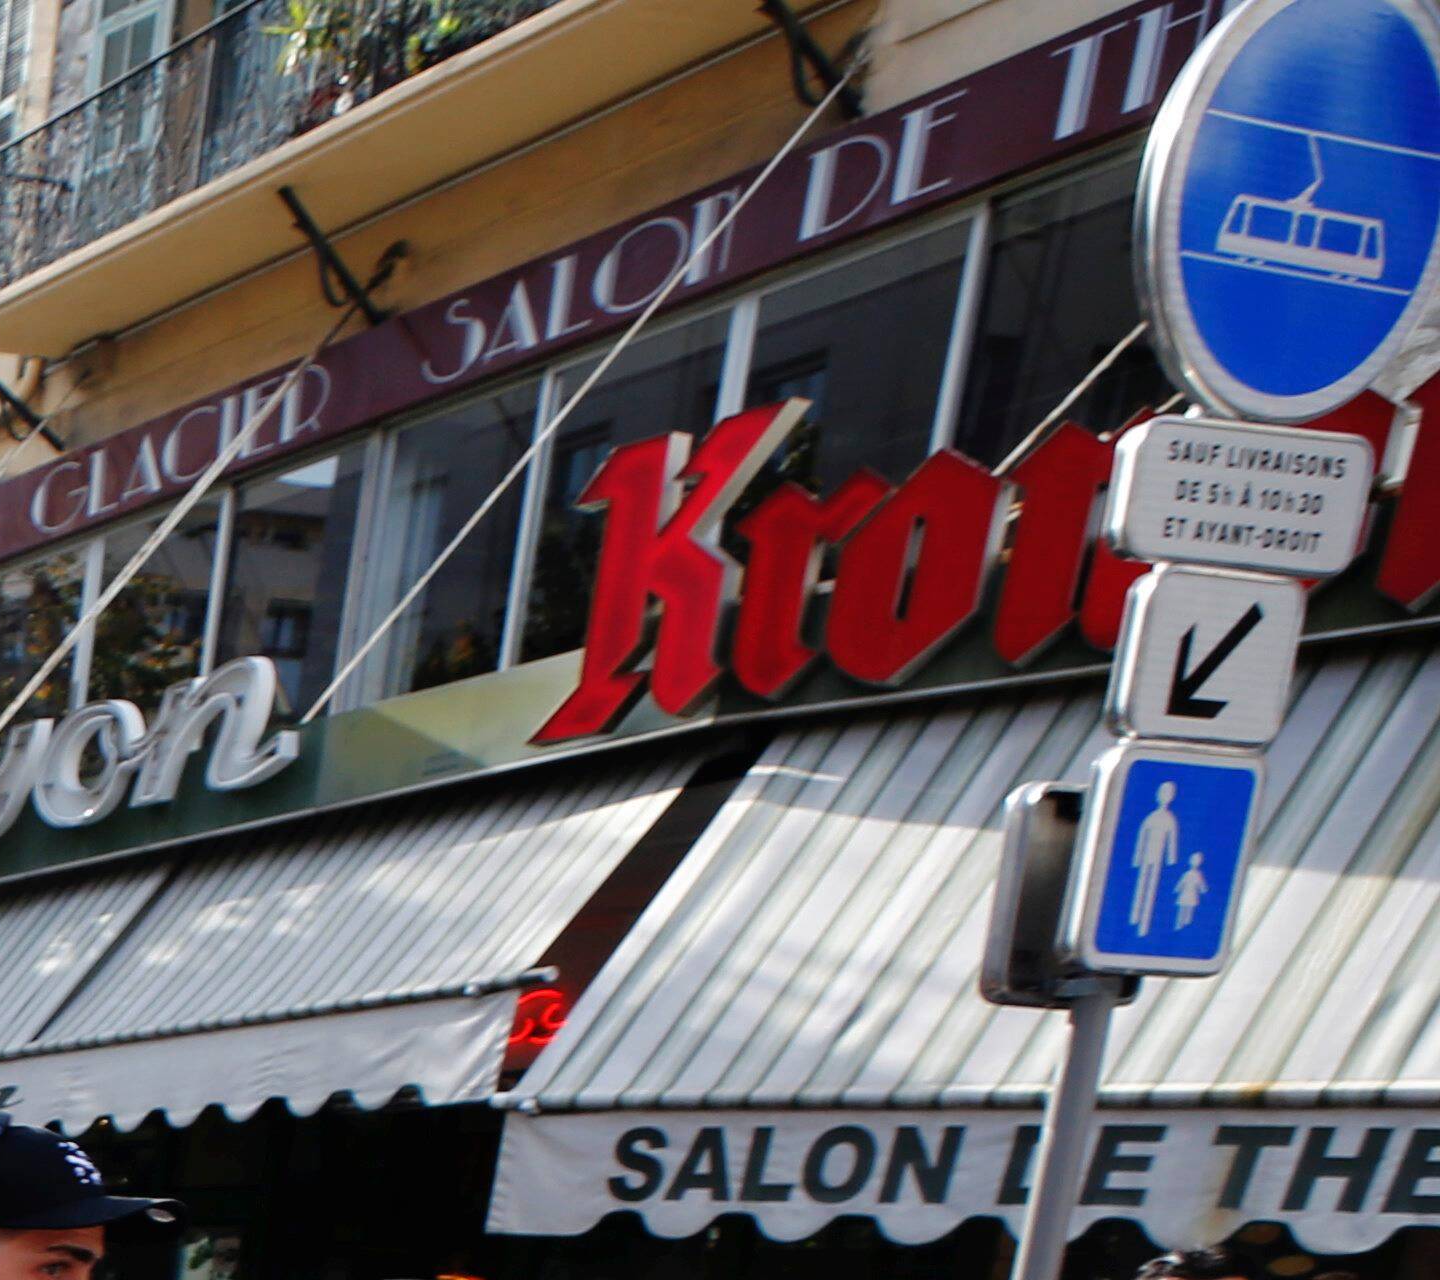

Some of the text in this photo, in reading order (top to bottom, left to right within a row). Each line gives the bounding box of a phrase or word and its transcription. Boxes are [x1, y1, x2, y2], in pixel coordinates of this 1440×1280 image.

[30, 364, 331, 535] GLACIER
[420, 189, 746, 386] SALON
[798, 90, 967, 242] DE
[1166, 439, 1348, 480] SAUF LIVRAISONS
[1174, 479, 1202, 502] DE
[1163, 516, 1322, 553] ET AYANT-DROIT
[607, 1124, 970, 1204] SALON
